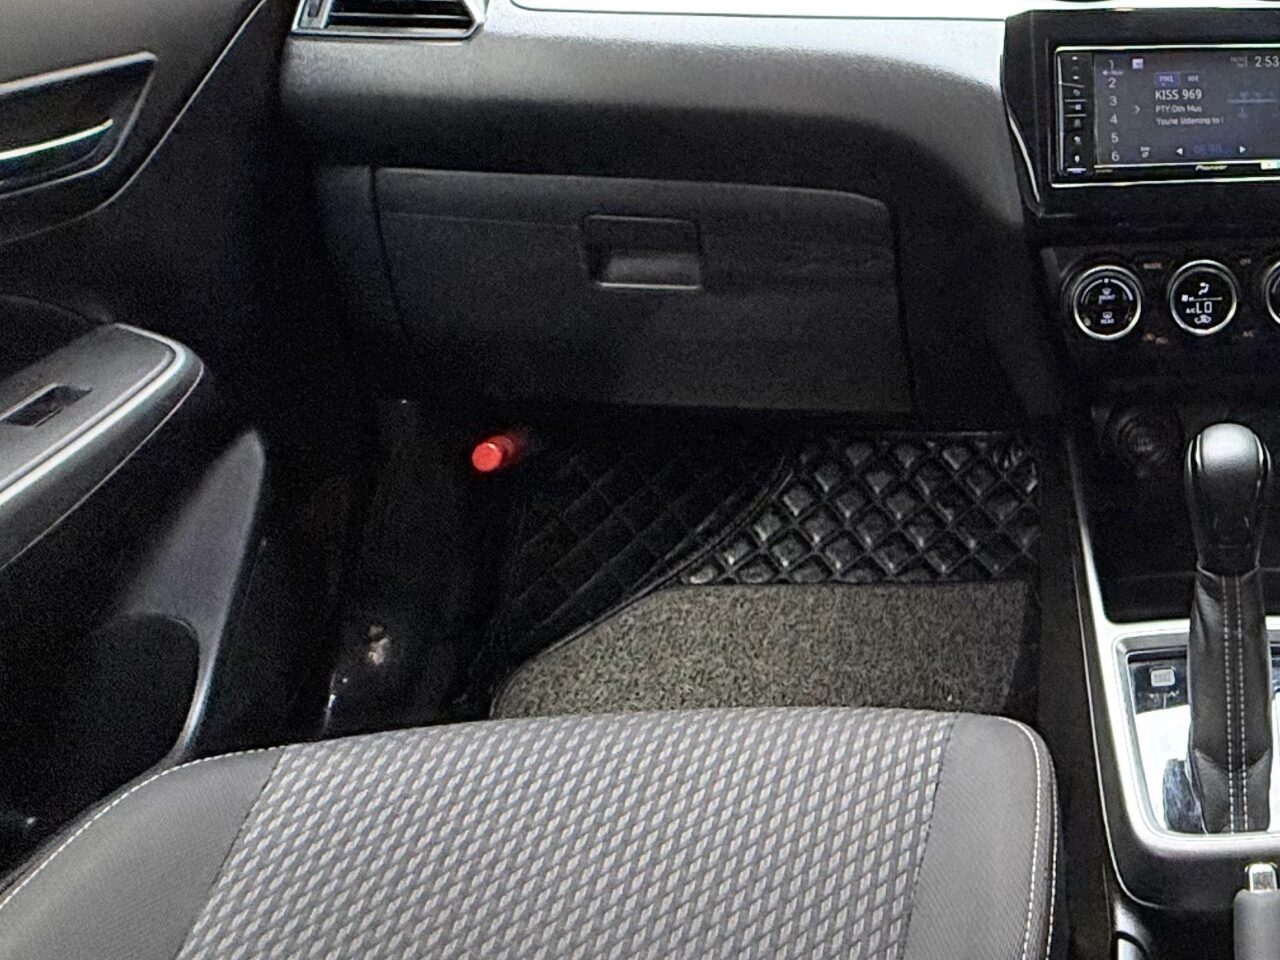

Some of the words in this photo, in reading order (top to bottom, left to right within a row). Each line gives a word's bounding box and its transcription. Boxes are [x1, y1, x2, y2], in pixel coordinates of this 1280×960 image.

[1254, 55, 1280, 68] 2:53
[1107, 76, 1117, 89] 2
[1155, 88, 1180, 100] KISS
[1181, 88, 1203, 100] 969
[1109, 95, 1118, 107] 3
[1110, 114, 1119, 125] 4
[1111, 133, 1119, 144] 5
[1111, 150, 1120, 162] 6
